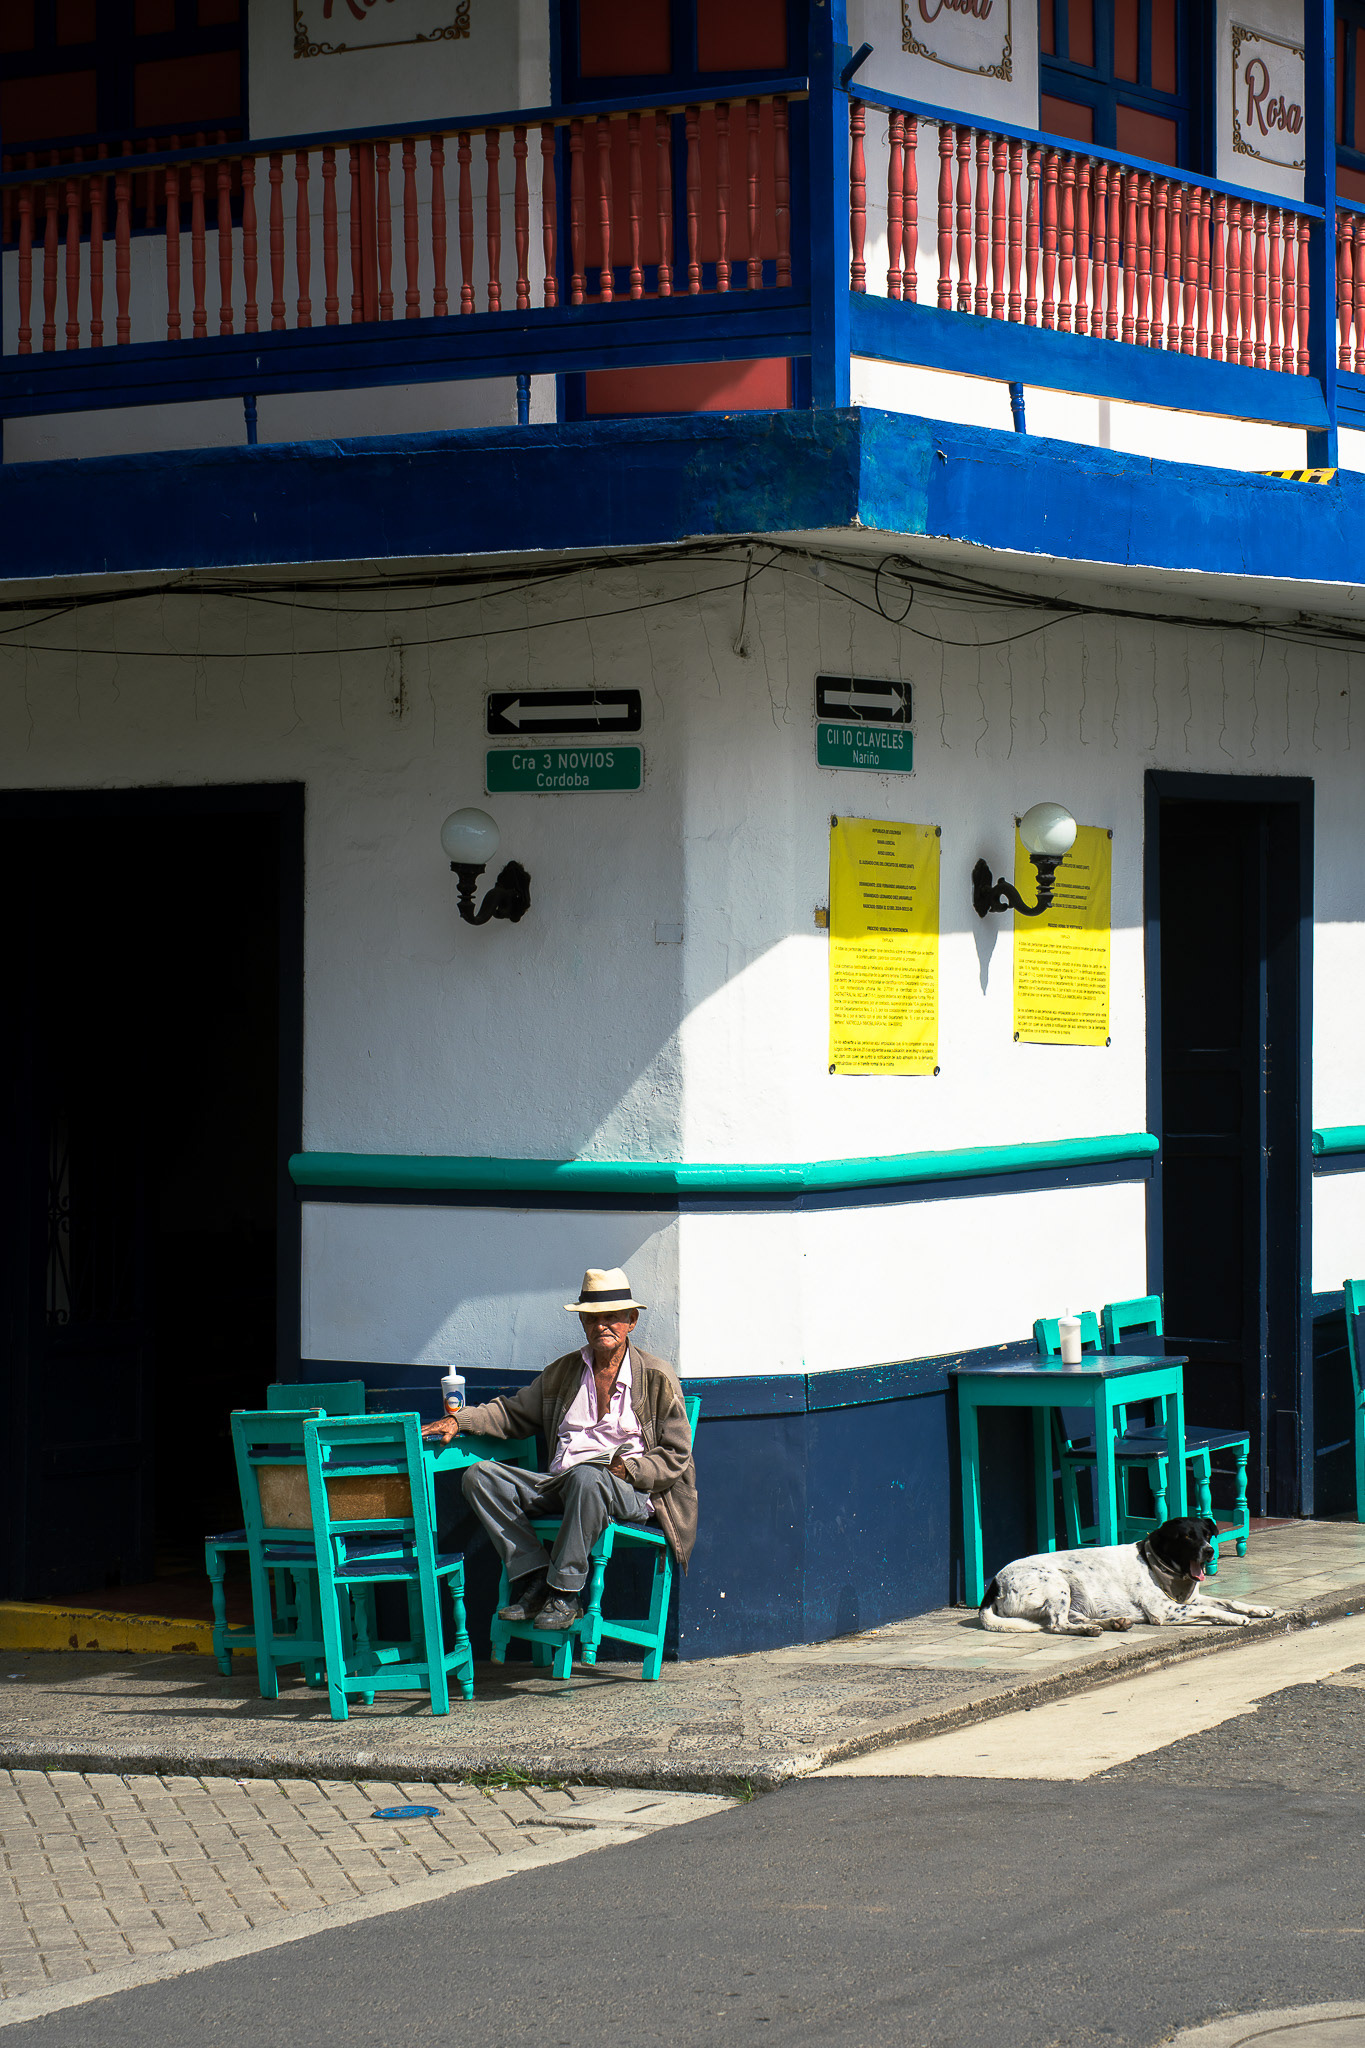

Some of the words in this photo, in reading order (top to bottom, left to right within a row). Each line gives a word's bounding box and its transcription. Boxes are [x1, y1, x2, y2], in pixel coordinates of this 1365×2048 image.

[1245, 58, 1304, 136] Rosa
[842, 730, 853, 746] 10
[856, 731, 904, 749] CLAVELES
[512, 755, 536, 770] Cra
[543, 754, 552, 769] 3
[558, 752, 615, 769] NOVIOS
[853, 750, 880, 765] Nariño
[536, 773, 590, 787] Cordoba
